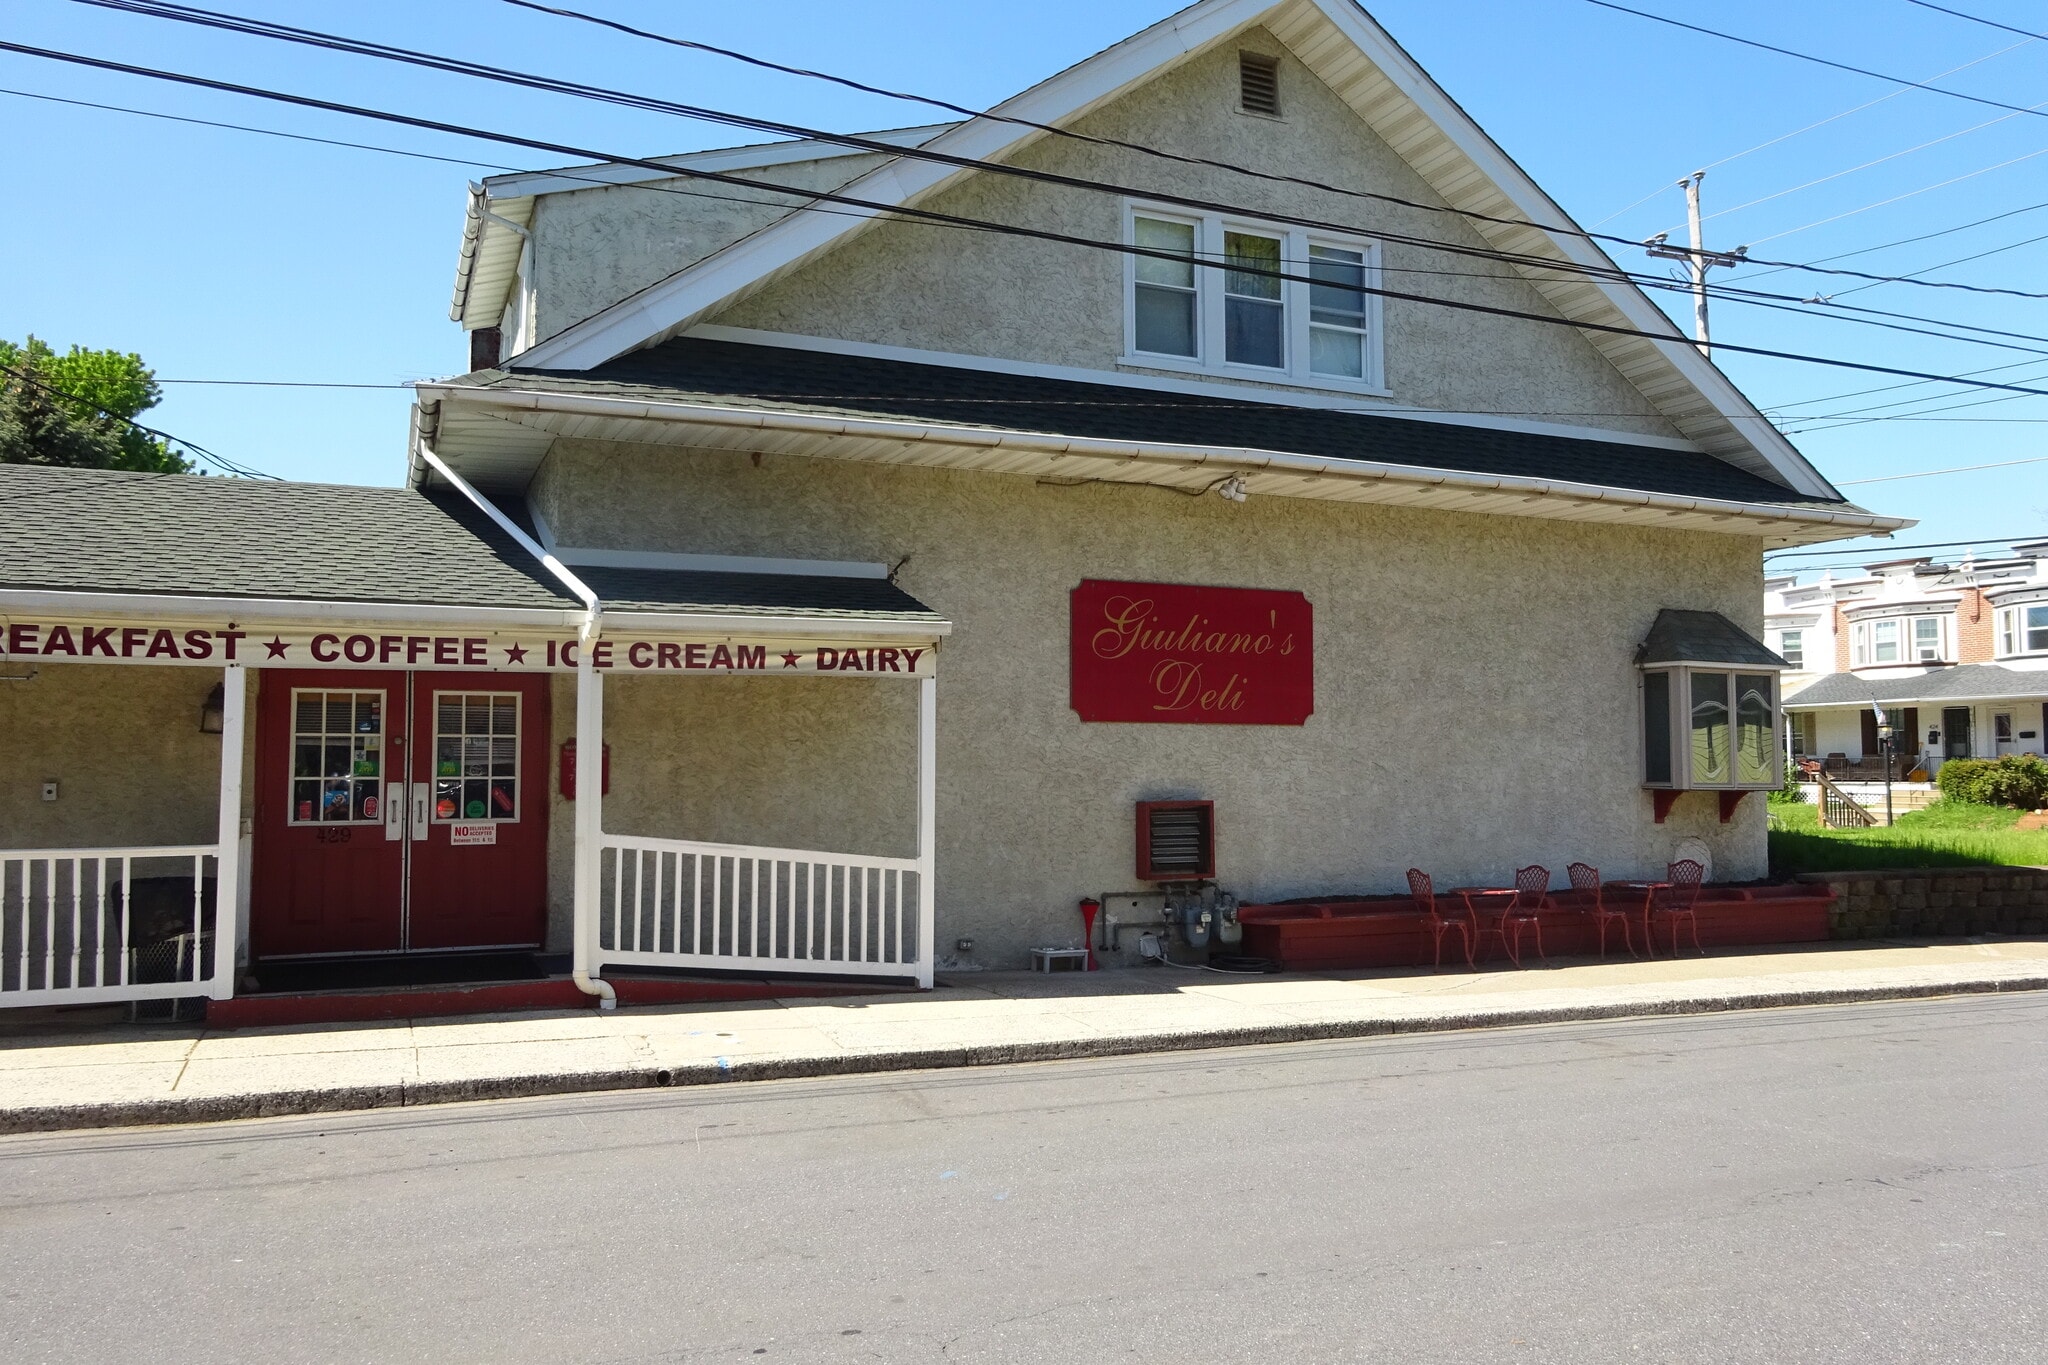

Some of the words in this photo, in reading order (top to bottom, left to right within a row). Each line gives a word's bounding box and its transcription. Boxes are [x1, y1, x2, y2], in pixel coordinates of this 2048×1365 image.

[0, 623, 247, 660] EAKFAST
[310, 633, 488, 666] COFFEE
[546, 640, 614, 668] ICE
[628, 642, 766, 670] CREAM
[816, 647, 924, 673] DAIRY
[1092, 595, 1296, 659] Giuliano's
[1149, 658, 1248, 711] Deli
[317, 827, 352, 843] 429
[454, 826, 469, 837] NO
